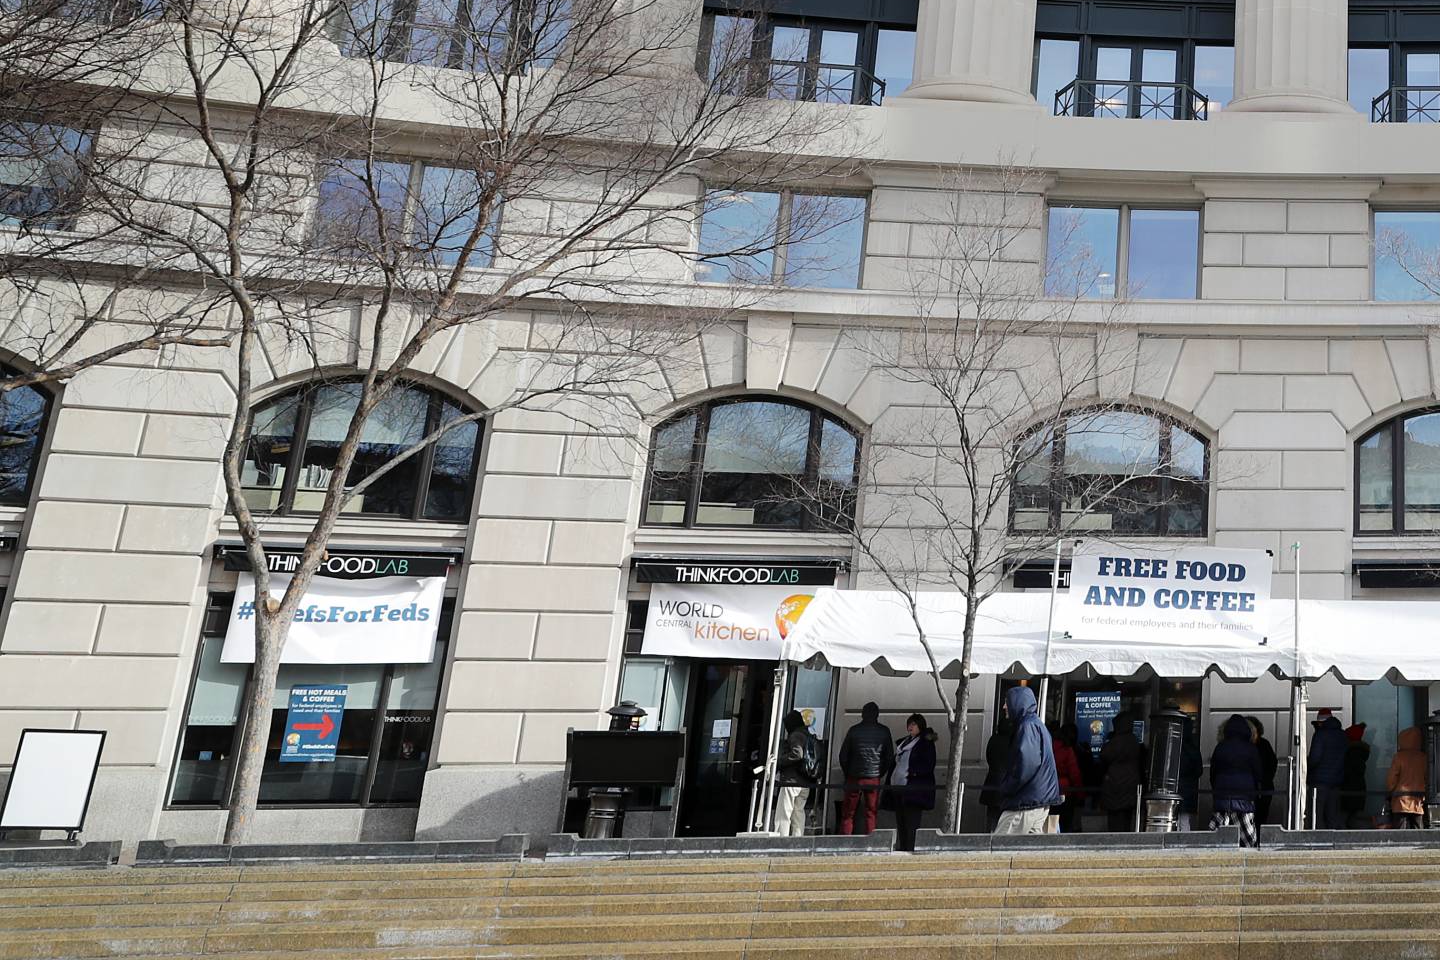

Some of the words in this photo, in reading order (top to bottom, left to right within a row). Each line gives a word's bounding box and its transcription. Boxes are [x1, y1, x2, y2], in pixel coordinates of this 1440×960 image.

[675, 567, 800, 583] THINKFOODLAB
[1097, 557, 1168, 579] FREE
[1175, 560, 1246, 582] FOOD
[659, 600, 724, 618] WORLD
[1083, 585, 1146, 608] AND
[1153, 589, 1256, 612] COFFEE
[237, 602, 430, 623] #efsForFeds
[1081, 616, 1095, 624] for
[1096, 616, 1128, 625] federal
[1129, 619, 1176, 628] employees
[1179, 621, 1195, 629] and
[1198, 621, 1217, 630] their
[655, 618, 692, 628] CENTRAL
[694, 621, 769, 641] kitchen
